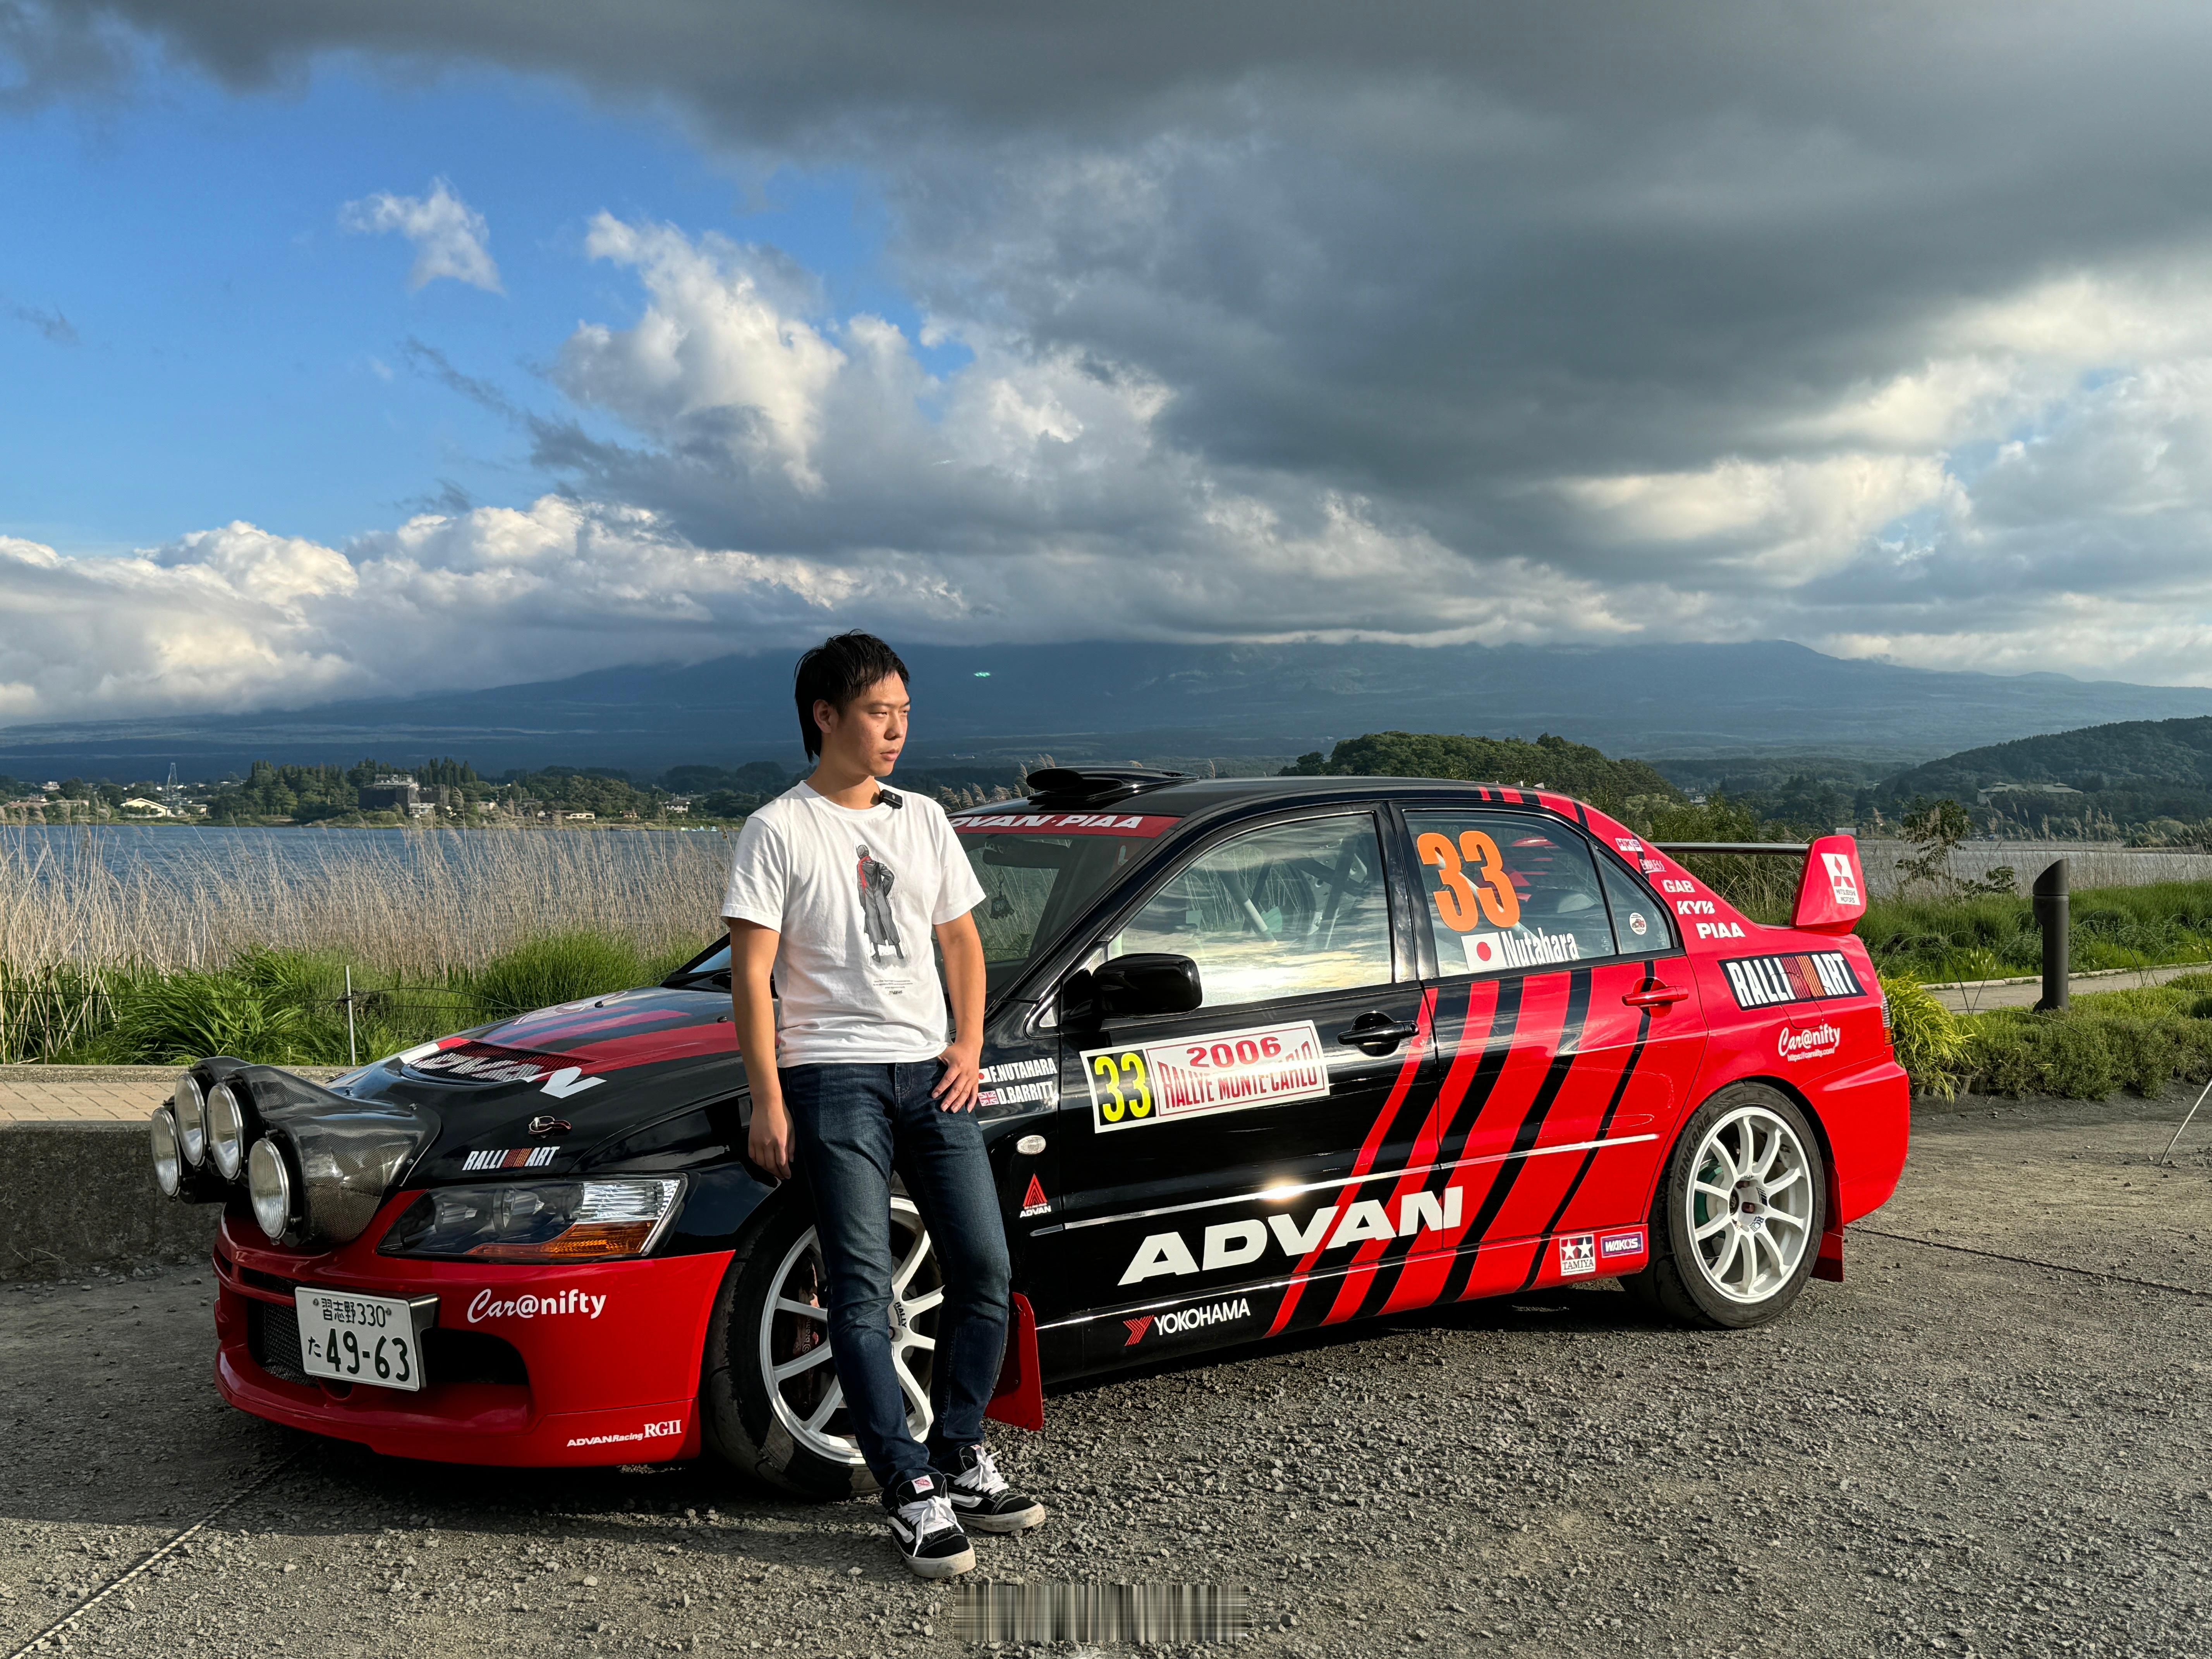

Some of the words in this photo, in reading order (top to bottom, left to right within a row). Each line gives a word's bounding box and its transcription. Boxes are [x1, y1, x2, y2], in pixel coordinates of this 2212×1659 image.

[949, 815, 1047, 828] DVAN
[1055, 815, 1143, 828] PIAA
[1616, 838, 1642, 849] HKS
[1417, 831, 1520, 932] 33
[1661, 879, 1695, 892] GAB
[1676, 900, 1715, 915] KYB
[1695, 922, 1746, 939] PIAA
[1501, 927, 1580, 967] Nutahara
[1186, 1036, 1281, 1068] 2006
[1778, 1023, 1841, 1056] Car@nifty
[989, 1058, 1058, 1083] F.NUTAHARA
[1094, 1052, 1151, 1121] 33
[1020, 1205, 1051, 1218] ADVAN
[1118, 1186, 1463, 1286] ADVAN
[1562, 1259, 1594, 1270] TAMIYA
[467, 1288, 606, 1323] Car@nifty
[1154, 1298, 1250, 1335] YOKOHAMA
[308, 1336, 321, 1357] た
[326, 1328, 410, 1381] 49-63
